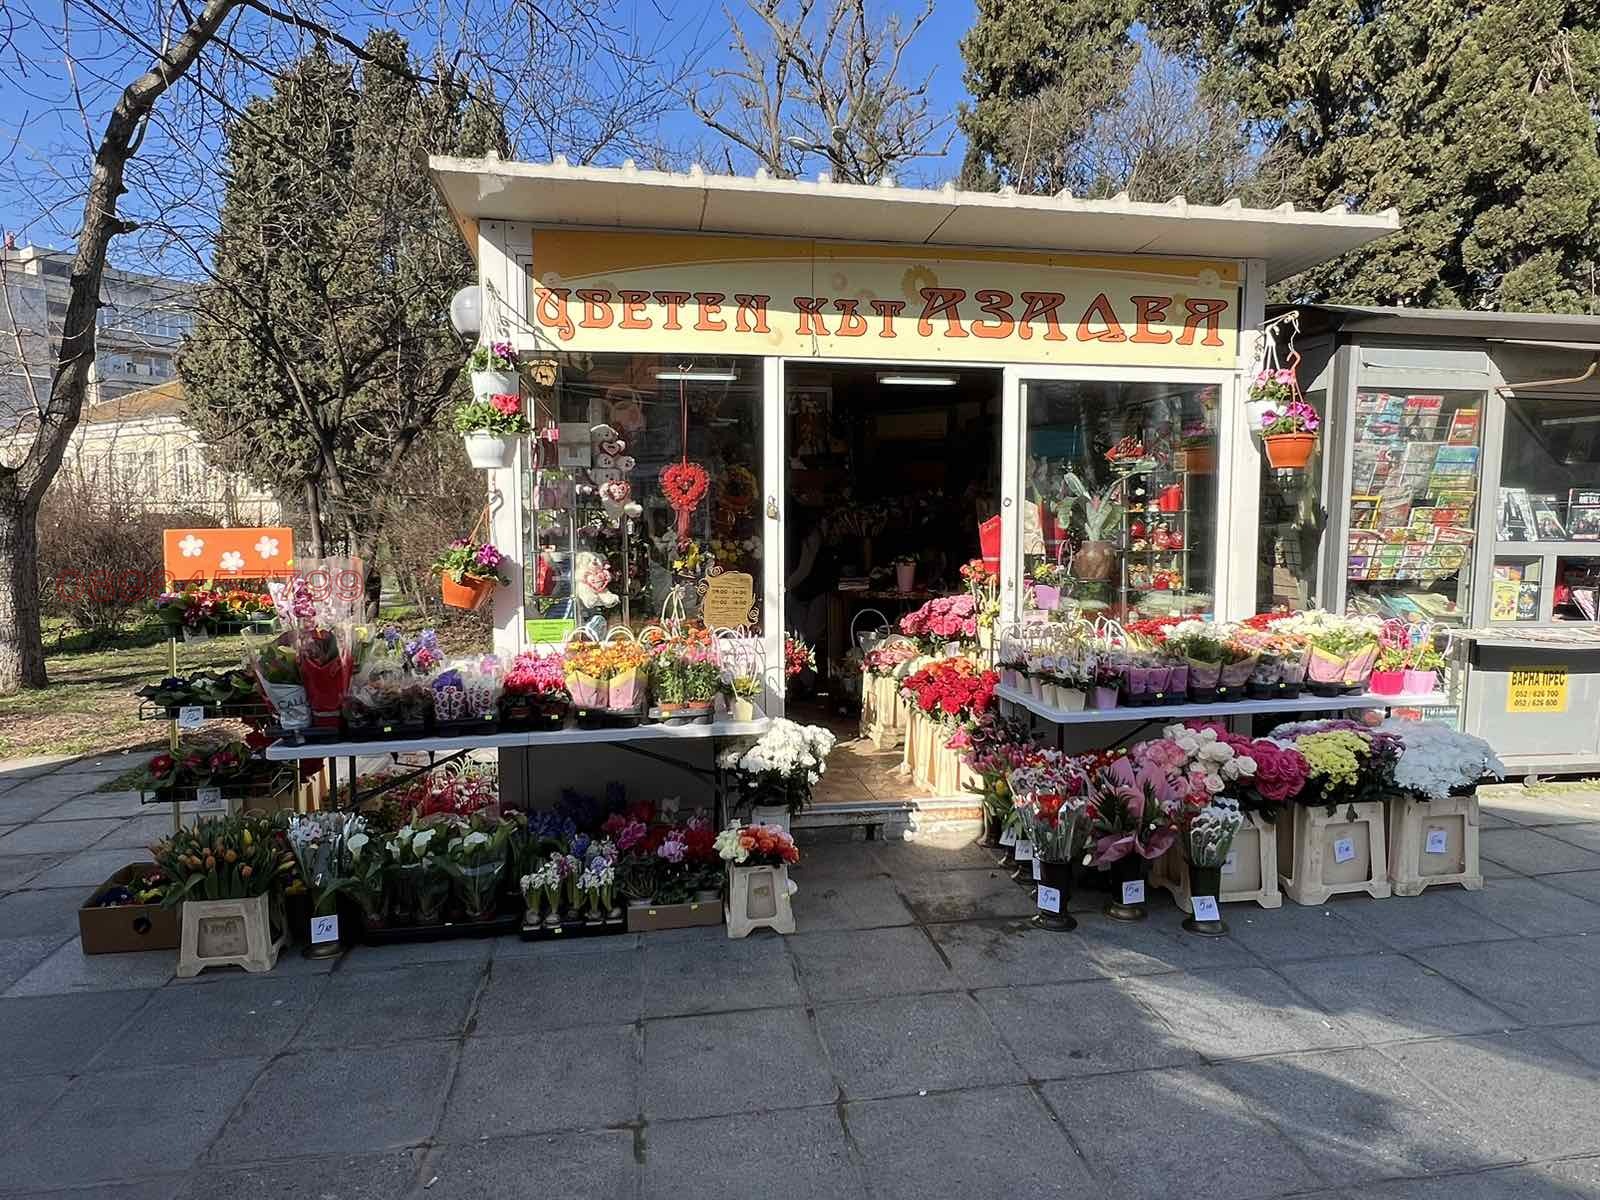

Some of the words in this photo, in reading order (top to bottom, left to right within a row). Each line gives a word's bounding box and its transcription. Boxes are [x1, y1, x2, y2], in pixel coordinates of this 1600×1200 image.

[535, 288, 771, 341] ЦВЕТЕН
[794, 296, 906, 338] КЪТ
[1512, 671, 1540, 686] ВАРНА
[1543, 670, 1565, 686] ПРЕС
